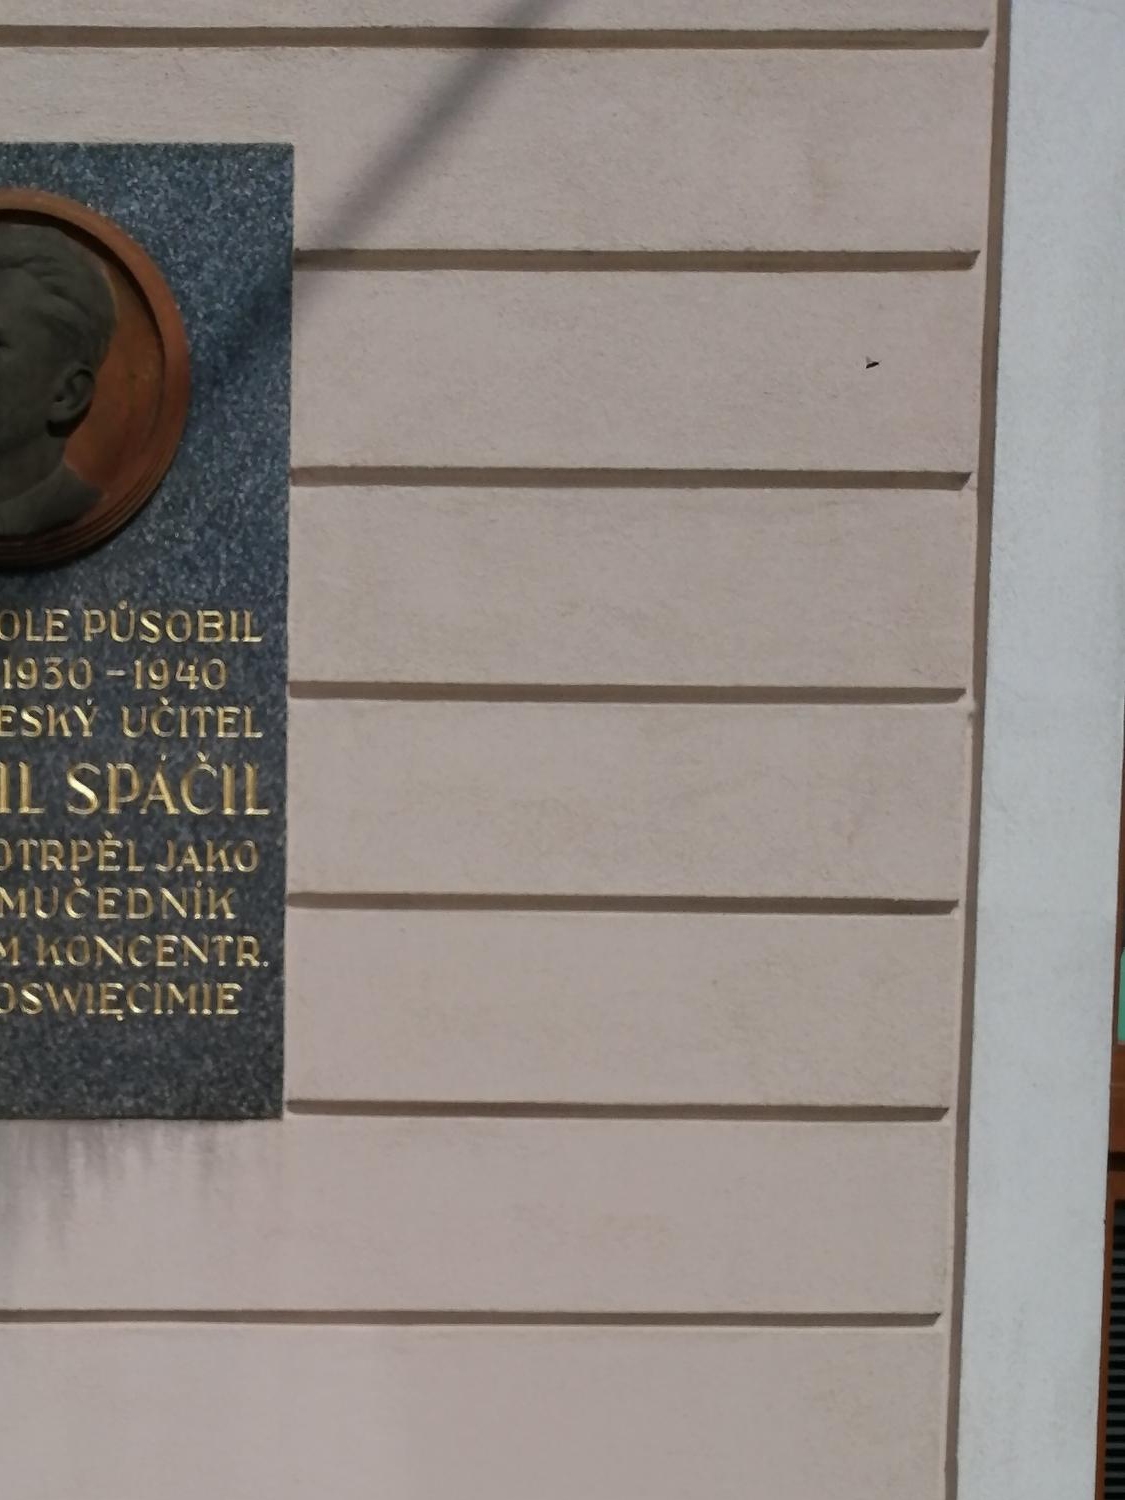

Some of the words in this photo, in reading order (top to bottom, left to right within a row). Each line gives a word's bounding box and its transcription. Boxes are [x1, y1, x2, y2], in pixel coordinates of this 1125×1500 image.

[82, 600, 263, 643] PŮSOBIL
[122, 696, 263, 738] UČITEL
[67, 751, 270, 815] SPÁČIL
[155, 839, 260, 872] JAKO
[36, 934, 269, 967] KONCENTR.
